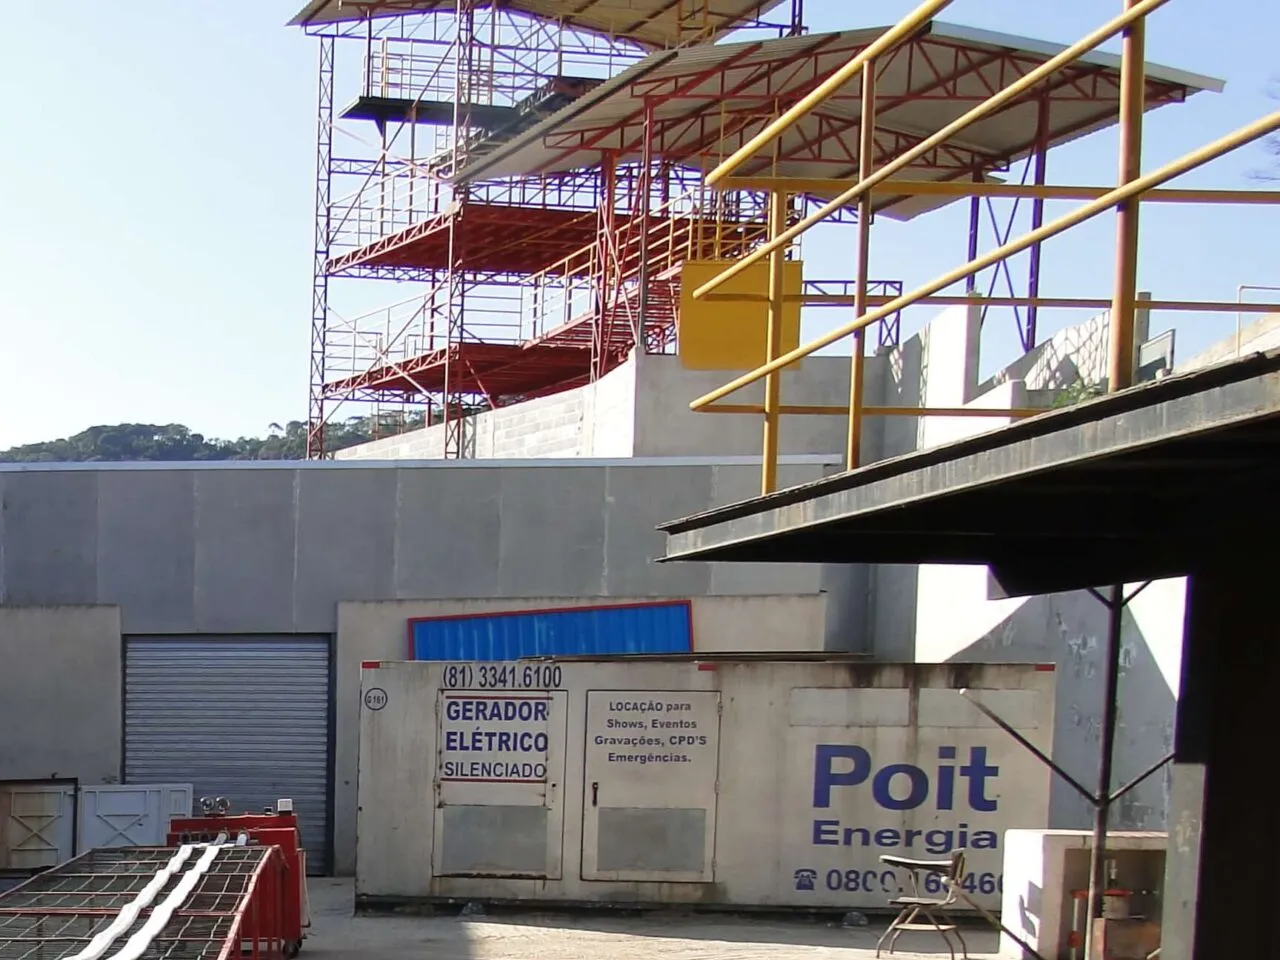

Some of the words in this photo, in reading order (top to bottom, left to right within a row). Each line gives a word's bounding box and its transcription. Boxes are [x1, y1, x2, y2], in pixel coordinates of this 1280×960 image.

[443, 665, 473, 688] (81)
[479, 665, 562, 688] 3341.6100
[446, 701, 548, 721] GERADOR
[609, 700, 663, 713] LOCAÇÃO
[666, 703, 691, 712] para
[607, 719, 648, 730] Shows,
[651, 719, 697, 729] Eventos
[446, 726, 549, 752] ELÉTRICO
[595, 735, 664, 747] Gravações,
[669, 736, 707, 745] CPD'S
[608, 752, 692, 764] Emergências.
[444, 762, 547, 778] SILENCIADO
[813, 744, 999, 811] Poit
[812, 820, 998, 854] Energia
